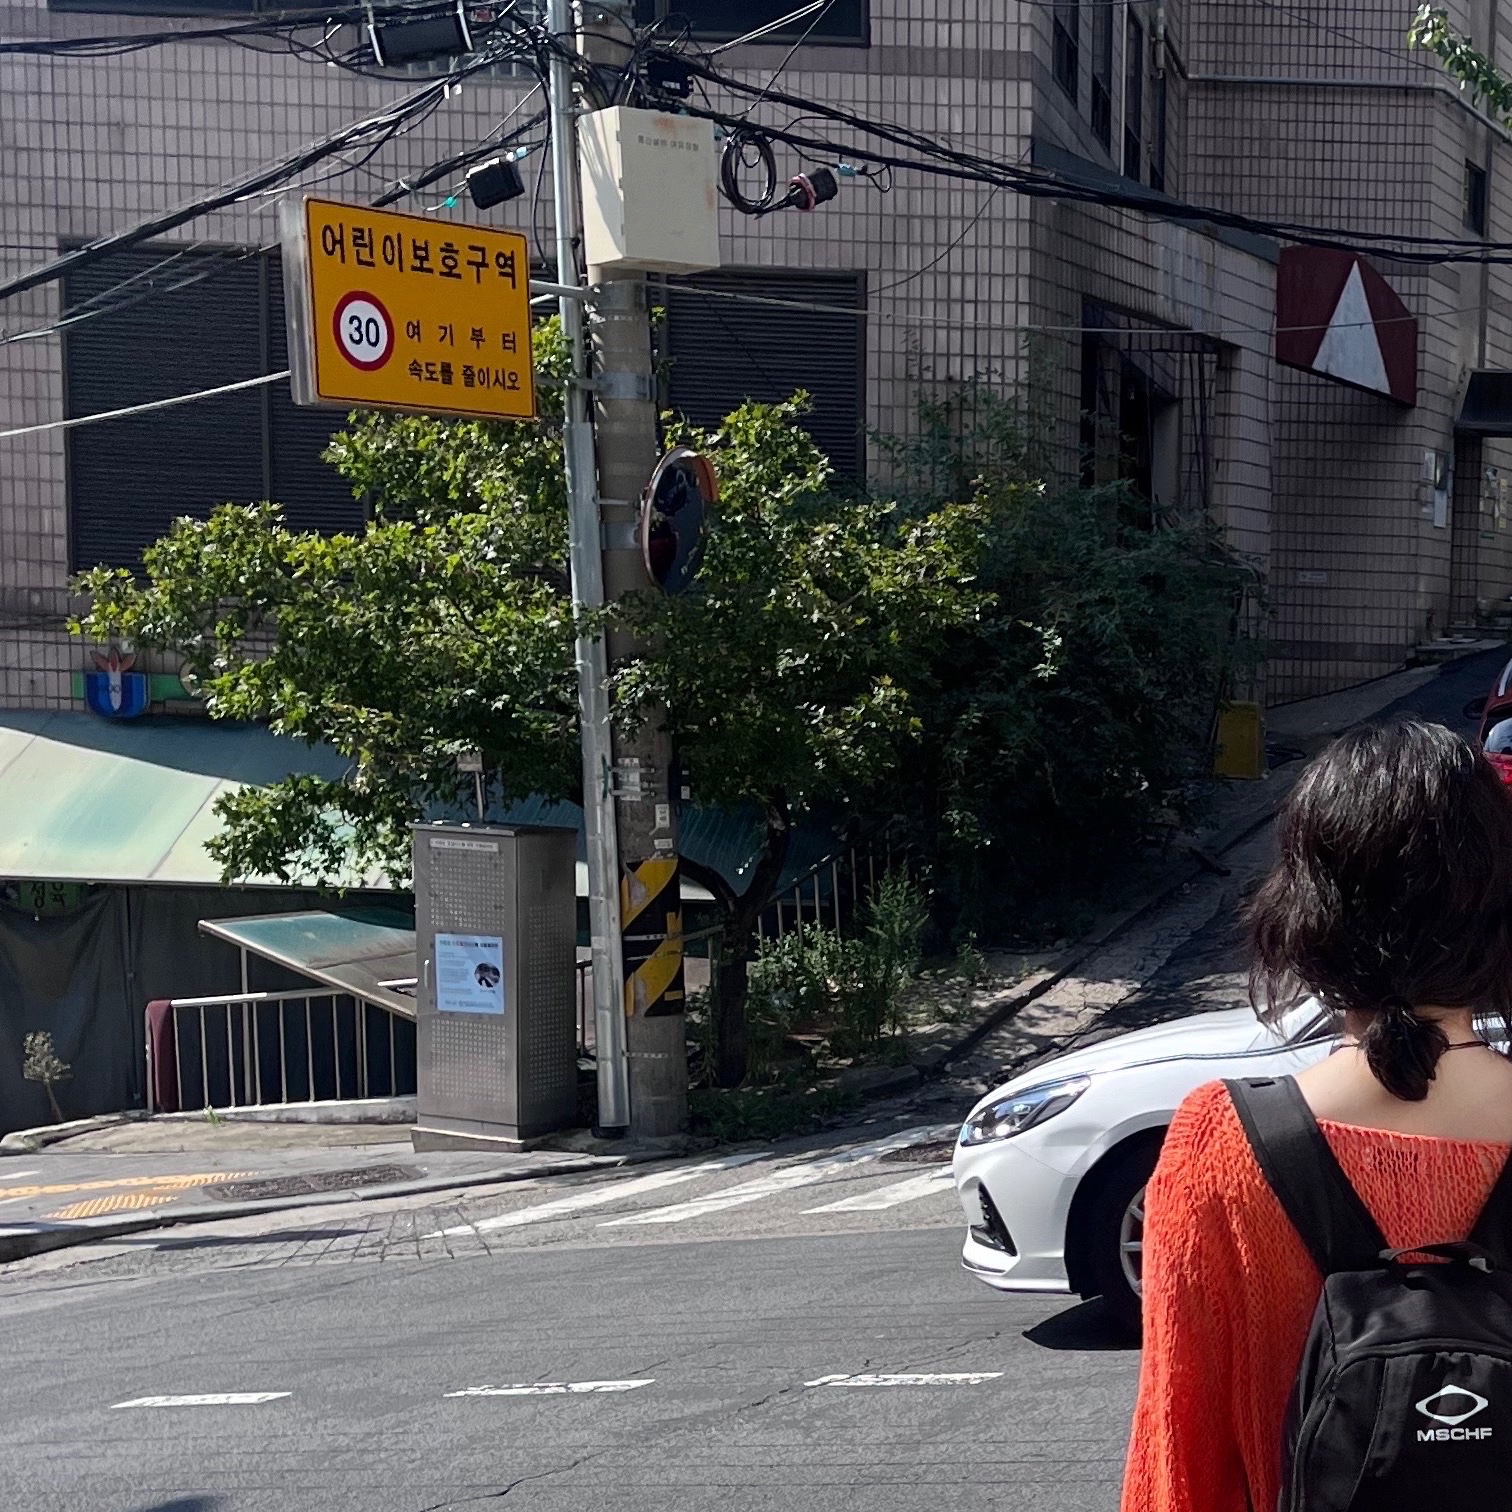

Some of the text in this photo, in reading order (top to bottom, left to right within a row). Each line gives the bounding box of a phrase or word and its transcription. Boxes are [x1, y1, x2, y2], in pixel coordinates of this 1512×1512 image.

[322, 223, 517, 289] 어린이보호구역
[348, 314, 380, 348] 30
[408, 358, 521, 391] 속도를 줄이시오
[1416, 1427, 1493, 1442] MSCHF
